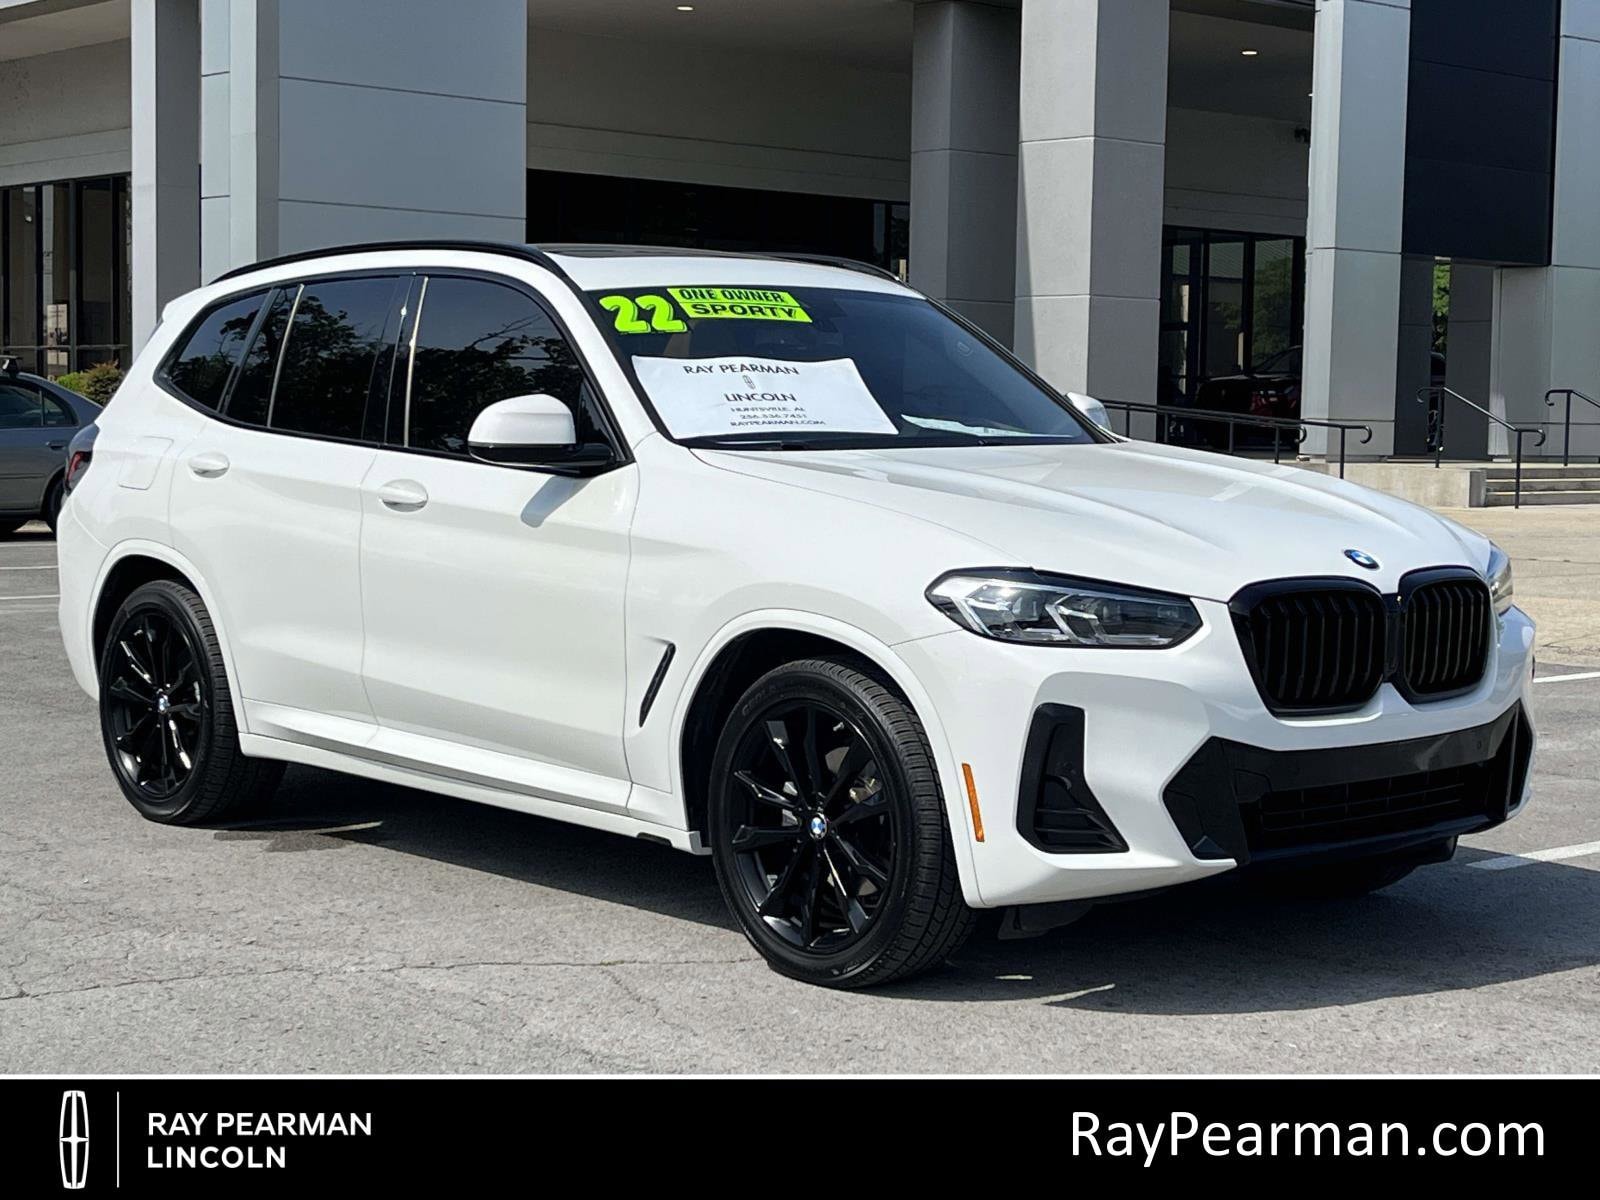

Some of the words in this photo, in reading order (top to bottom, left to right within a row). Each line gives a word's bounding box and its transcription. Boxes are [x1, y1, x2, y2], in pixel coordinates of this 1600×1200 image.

[679, 289, 716, 300] ONE
[722, 290, 784, 302] OWNER
[599, 295, 688, 333] 22
[692, 303, 796, 318] SPORTY
[683, 365, 714, 374] RAY
[719, 363, 800, 375] PEARMAN
[724, 392, 798, 402] LINCOLN
